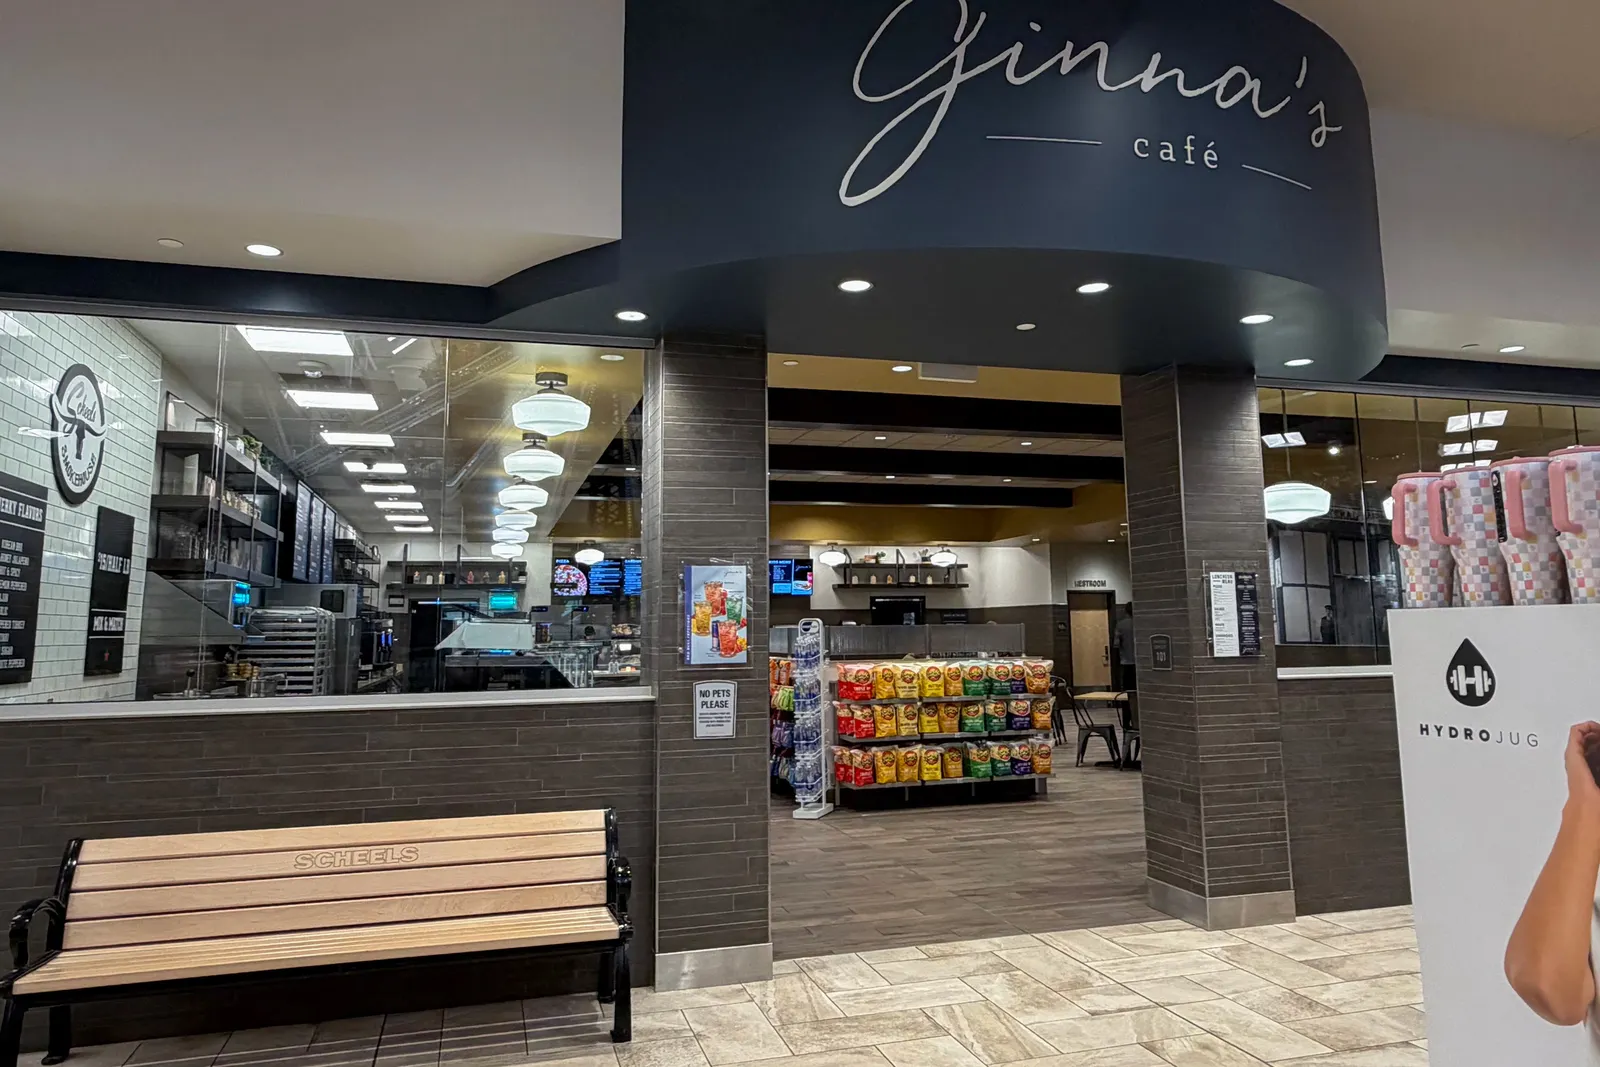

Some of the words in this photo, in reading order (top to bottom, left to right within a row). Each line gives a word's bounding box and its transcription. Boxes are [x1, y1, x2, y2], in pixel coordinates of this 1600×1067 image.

[1133, 135, 1218, 169] café
[61, 444, 97, 487] SMOKEHOUSE
[0, 497, 17, 515] ERKY
[18, 502, 43, 522] FLAVORS
[699, 690, 710, 698] NO
[712, 690, 731, 698] PETS
[701, 700, 729, 709] PLEASE
[1420, 723, 1539, 747] HYDROJUG
[294, 846, 419, 870] SCHEELS
